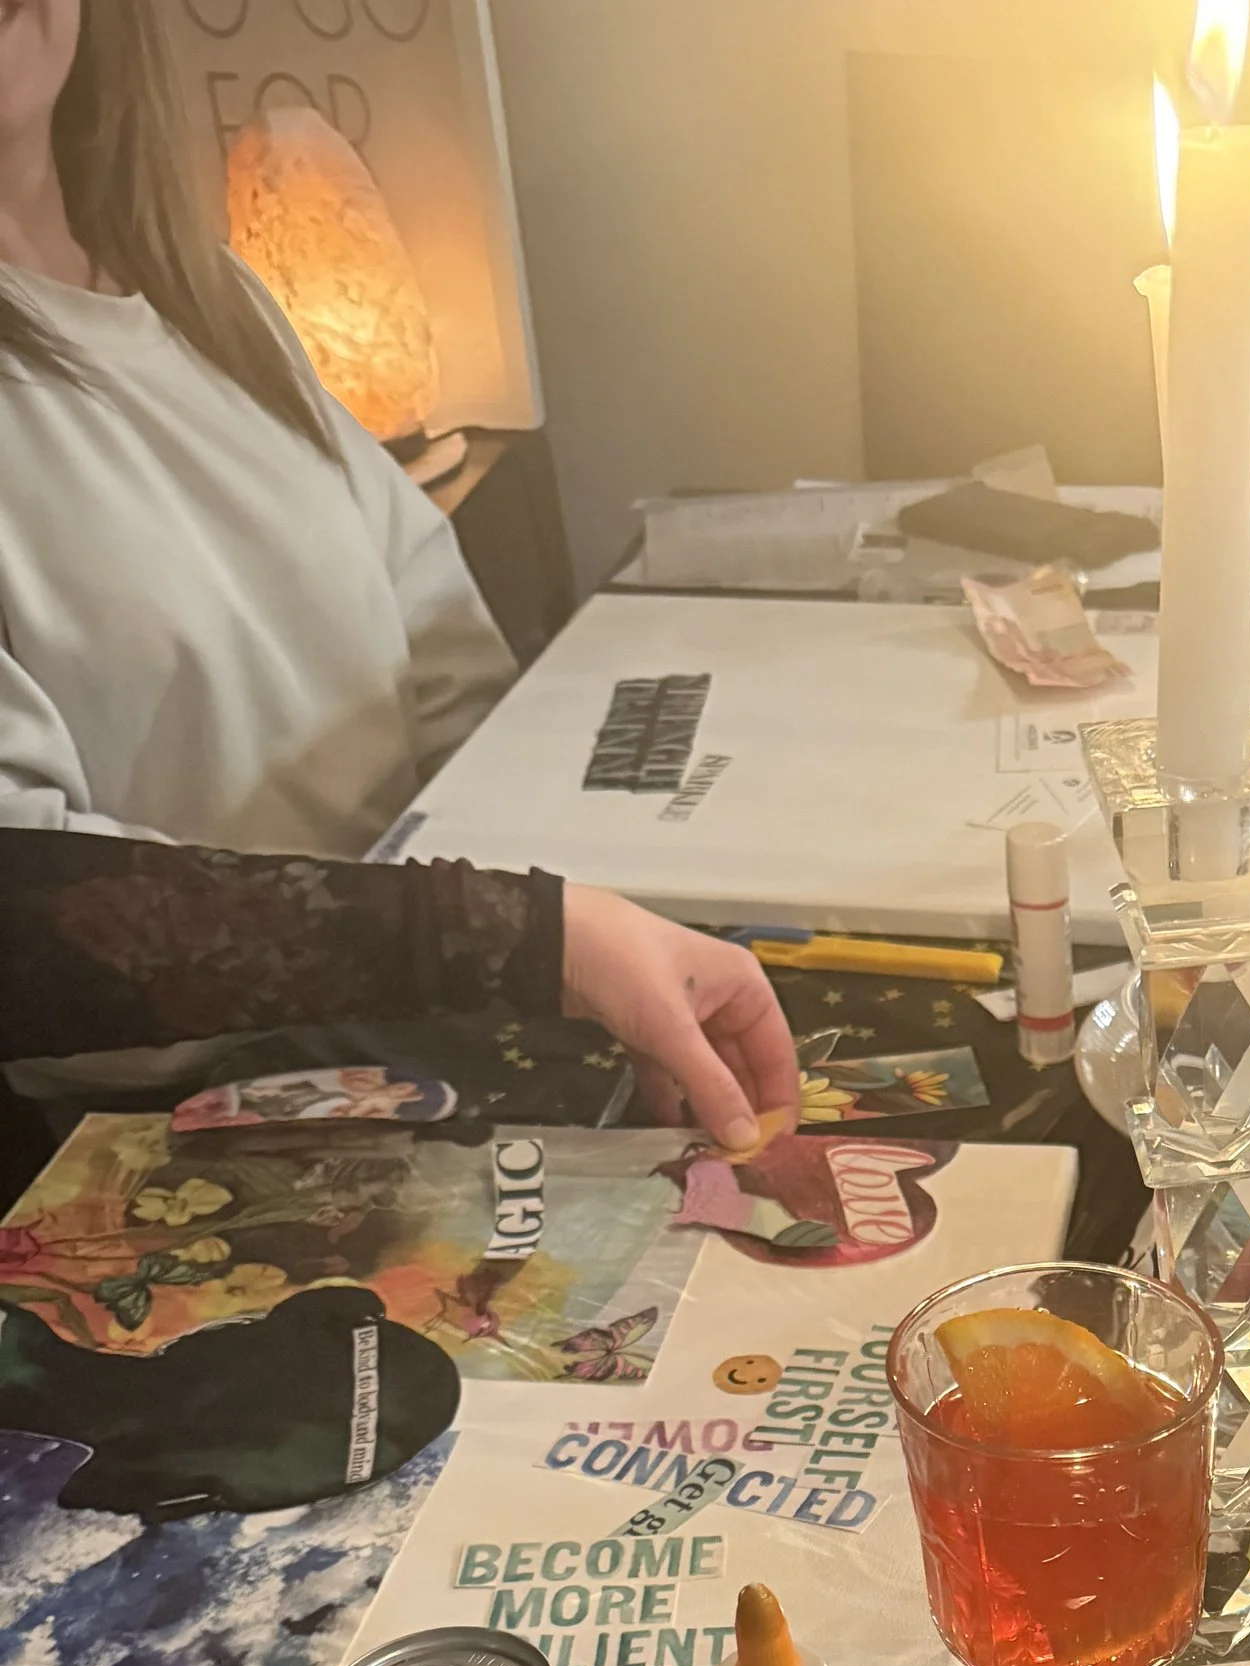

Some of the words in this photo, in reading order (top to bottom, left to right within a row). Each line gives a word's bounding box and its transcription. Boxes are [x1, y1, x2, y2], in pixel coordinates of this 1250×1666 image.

[804, 1324, 901, 1490] OURSELF
[545, 1432, 878, 1529] CONNCTED
[458, 1535, 723, 1586] BECOME
[488, 1583, 676, 1631] MORE
